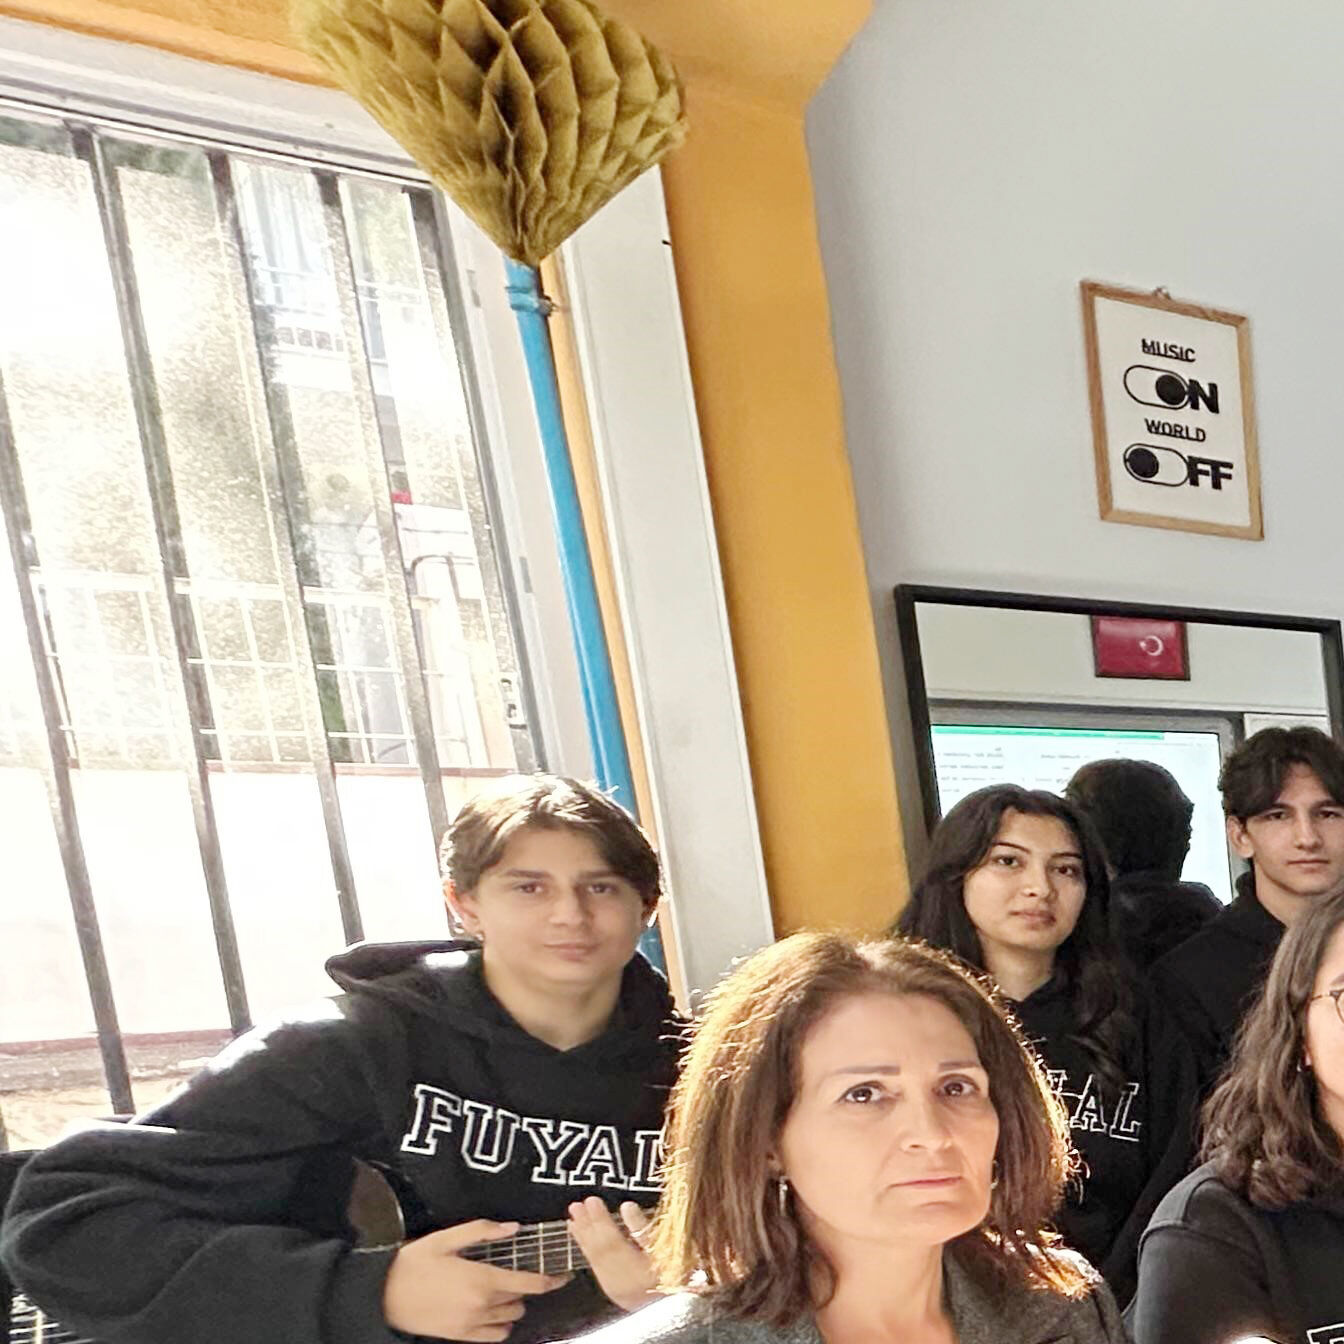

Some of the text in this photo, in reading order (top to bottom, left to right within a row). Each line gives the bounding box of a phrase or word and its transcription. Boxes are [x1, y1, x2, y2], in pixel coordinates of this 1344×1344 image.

[1141, 338, 1196, 363] MUSIC
[1144, 418, 1207, 443] WORLD
[1124, 443, 1234, 490] OFF
[400, 1083, 668, 1193] FUYAL
